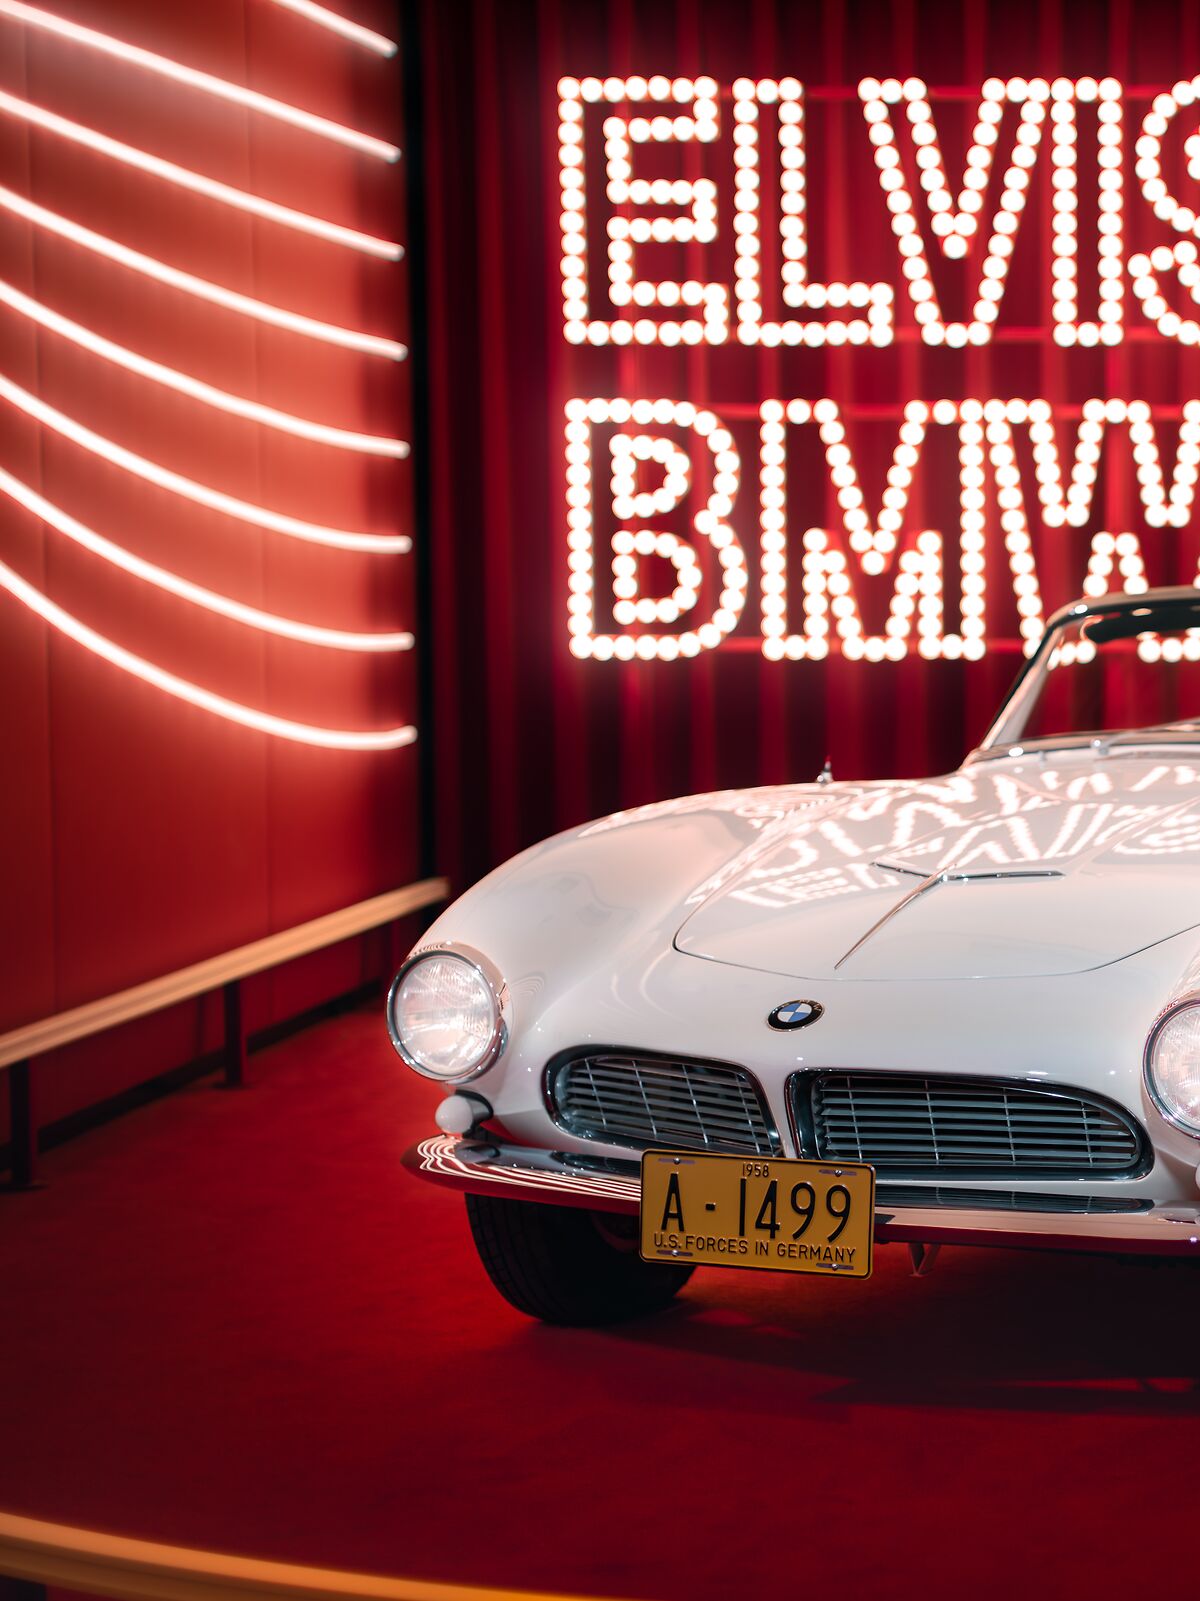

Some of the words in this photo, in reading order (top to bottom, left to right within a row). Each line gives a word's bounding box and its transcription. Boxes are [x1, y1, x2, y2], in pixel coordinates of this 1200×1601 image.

[742, 1163, 770, 1178] 1958
[654, 1233, 682, 1249] U.S.
[685, 1236, 748, 1254] FORCES
[755, 1241, 769, 1257] IN
[777, 1244, 856, 1264] GERMANY
